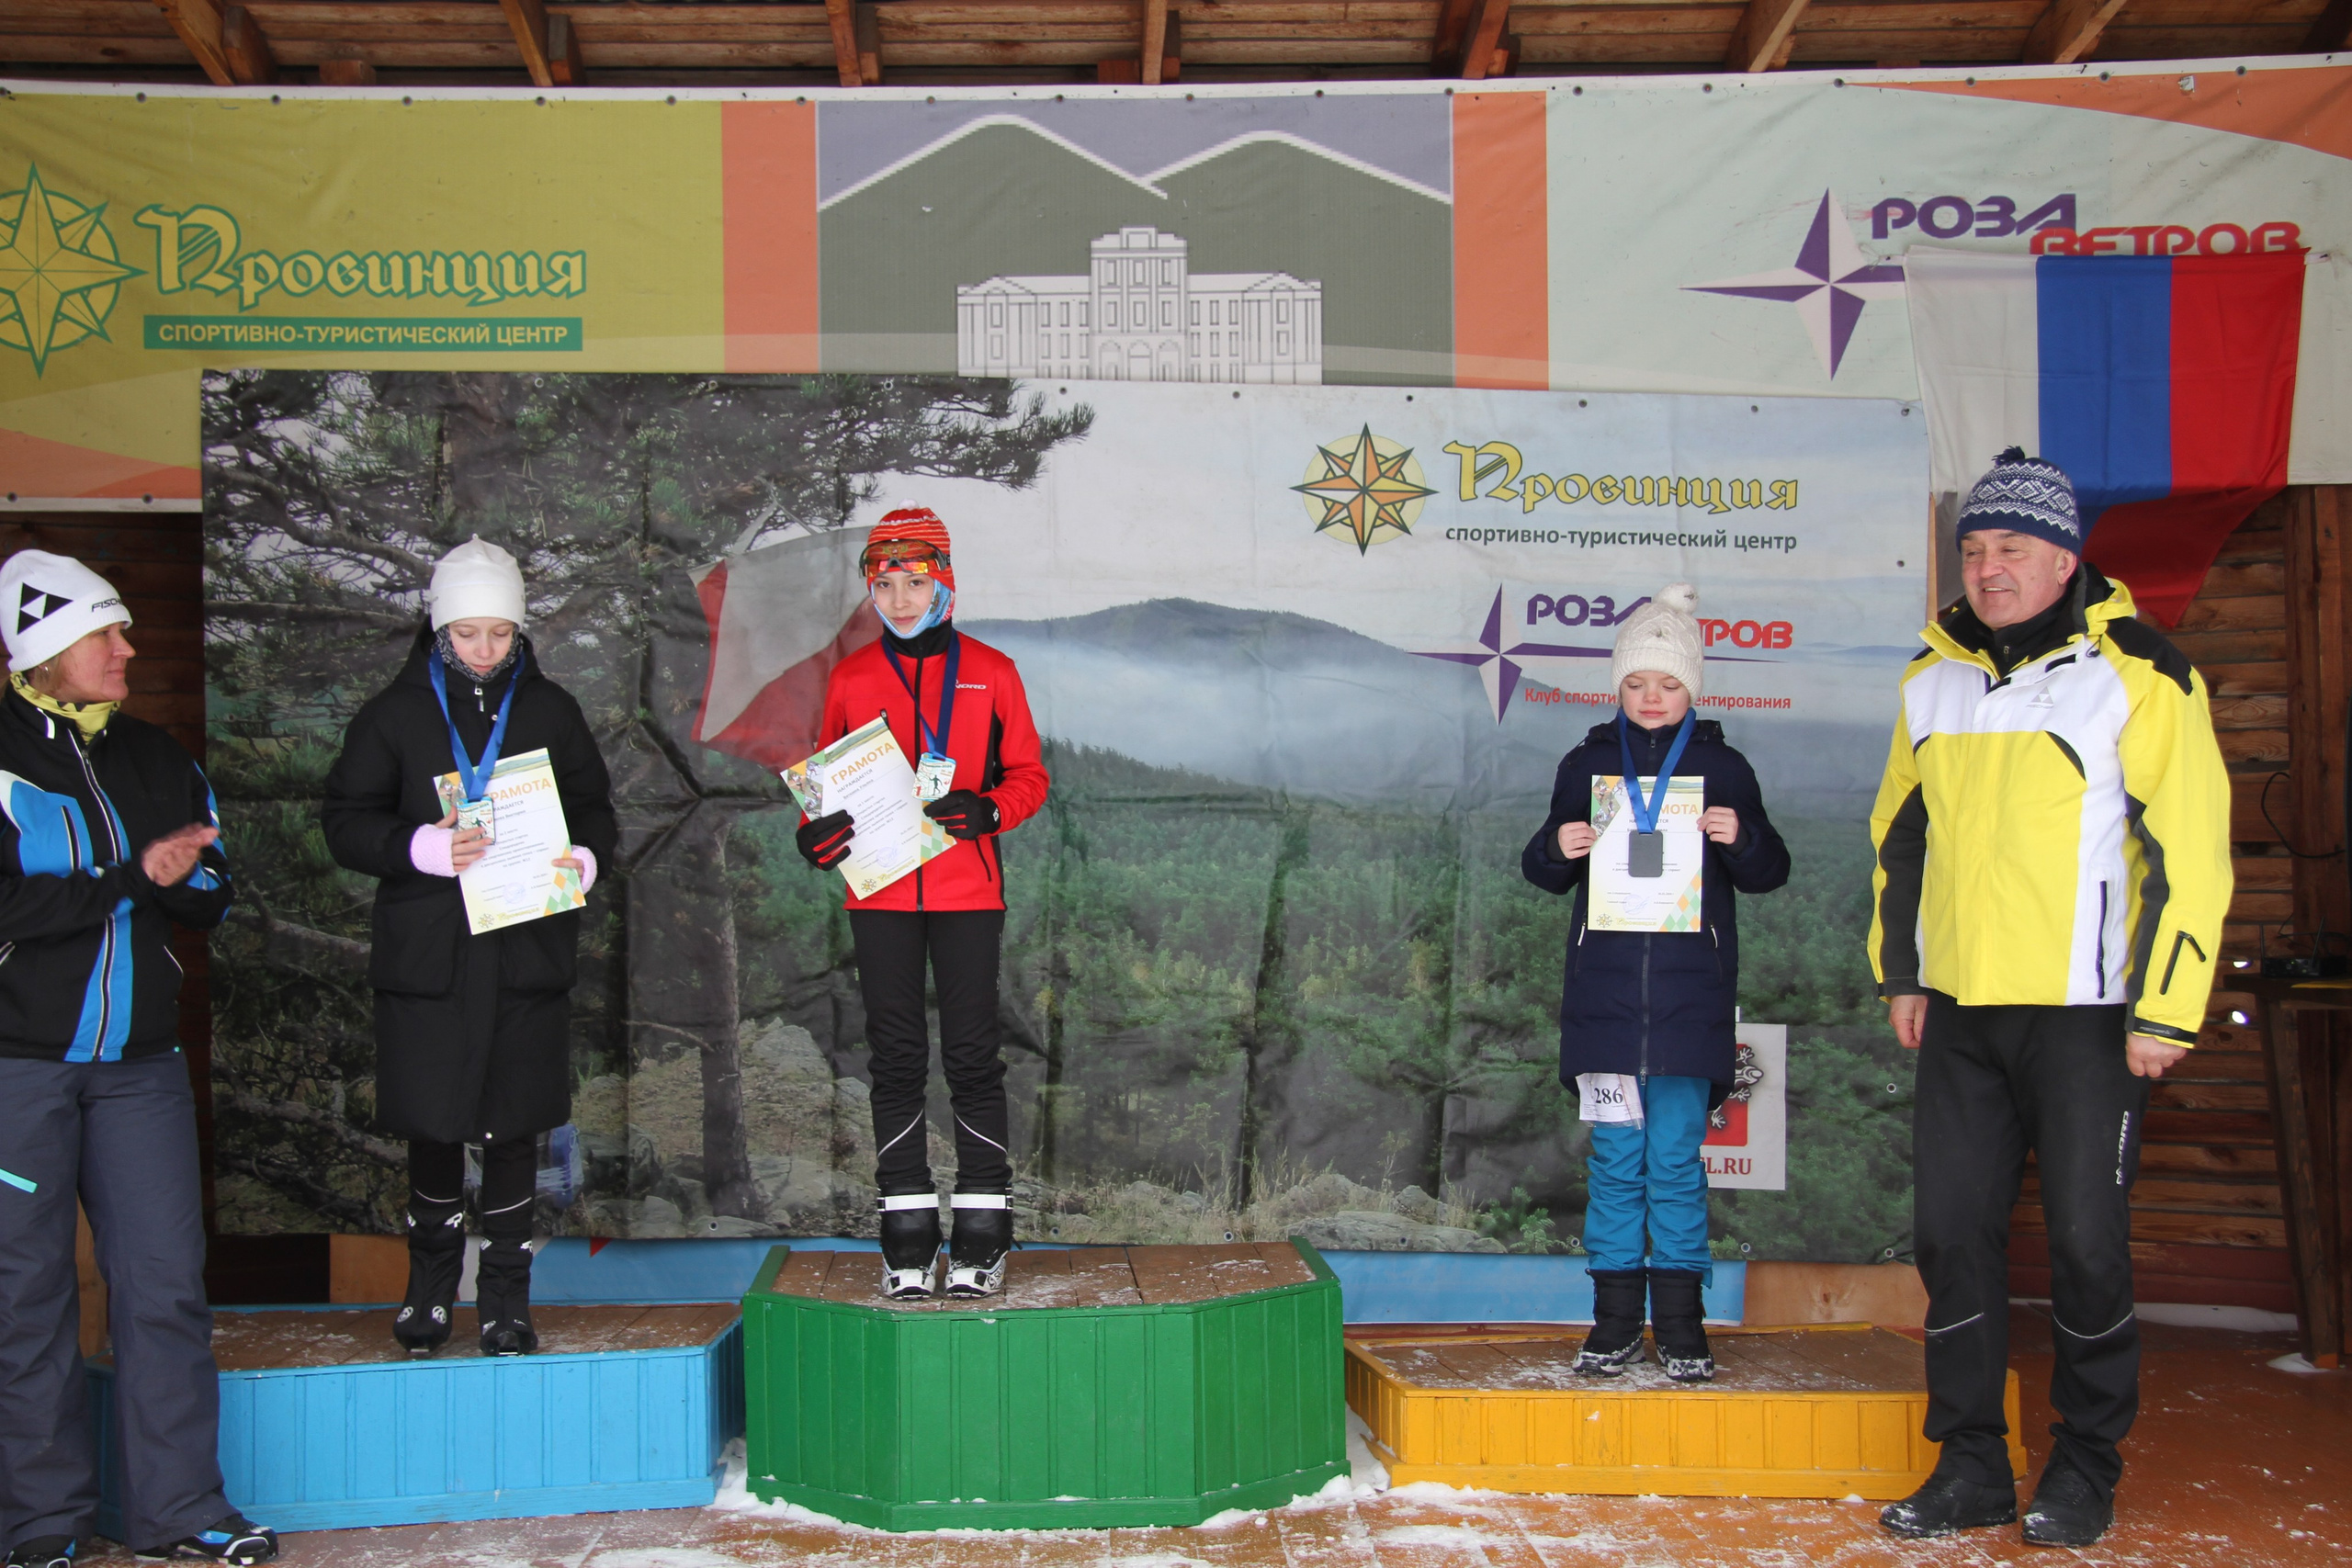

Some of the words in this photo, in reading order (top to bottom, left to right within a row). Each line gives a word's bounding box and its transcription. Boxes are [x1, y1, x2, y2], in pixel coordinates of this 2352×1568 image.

[1871, 193, 2076, 240] РОЗА
[133, 203, 586, 312] Провинция
[158, 322, 490, 344] СПОРТИВНО-ТУРИСТИЧЕСКИЙ
[497, 325, 569, 347] ЦЕНТР
[1442, 440, 1798, 514] Провинция
[1445, 525, 1727, 548] спортивно-туристический
[1734, 532, 1798, 553] центр
[1525, 687, 1561, 707] Клуб
[1565, 689, 1617, 707] спорти
[1695, 693, 1792, 711] ентирования
[831, 742, 895, 785] ГРАМОТА
[484, 778, 552, 802] РАМОТА
[837, 768, 873, 793] НАГРАЖДАЕТСЯ
[494, 800, 525, 812] РАЖДАЕТСЯ
[1594, 1087, 1624, 1105] 286
[1700, 1156, 1753, 1176] L.RU
